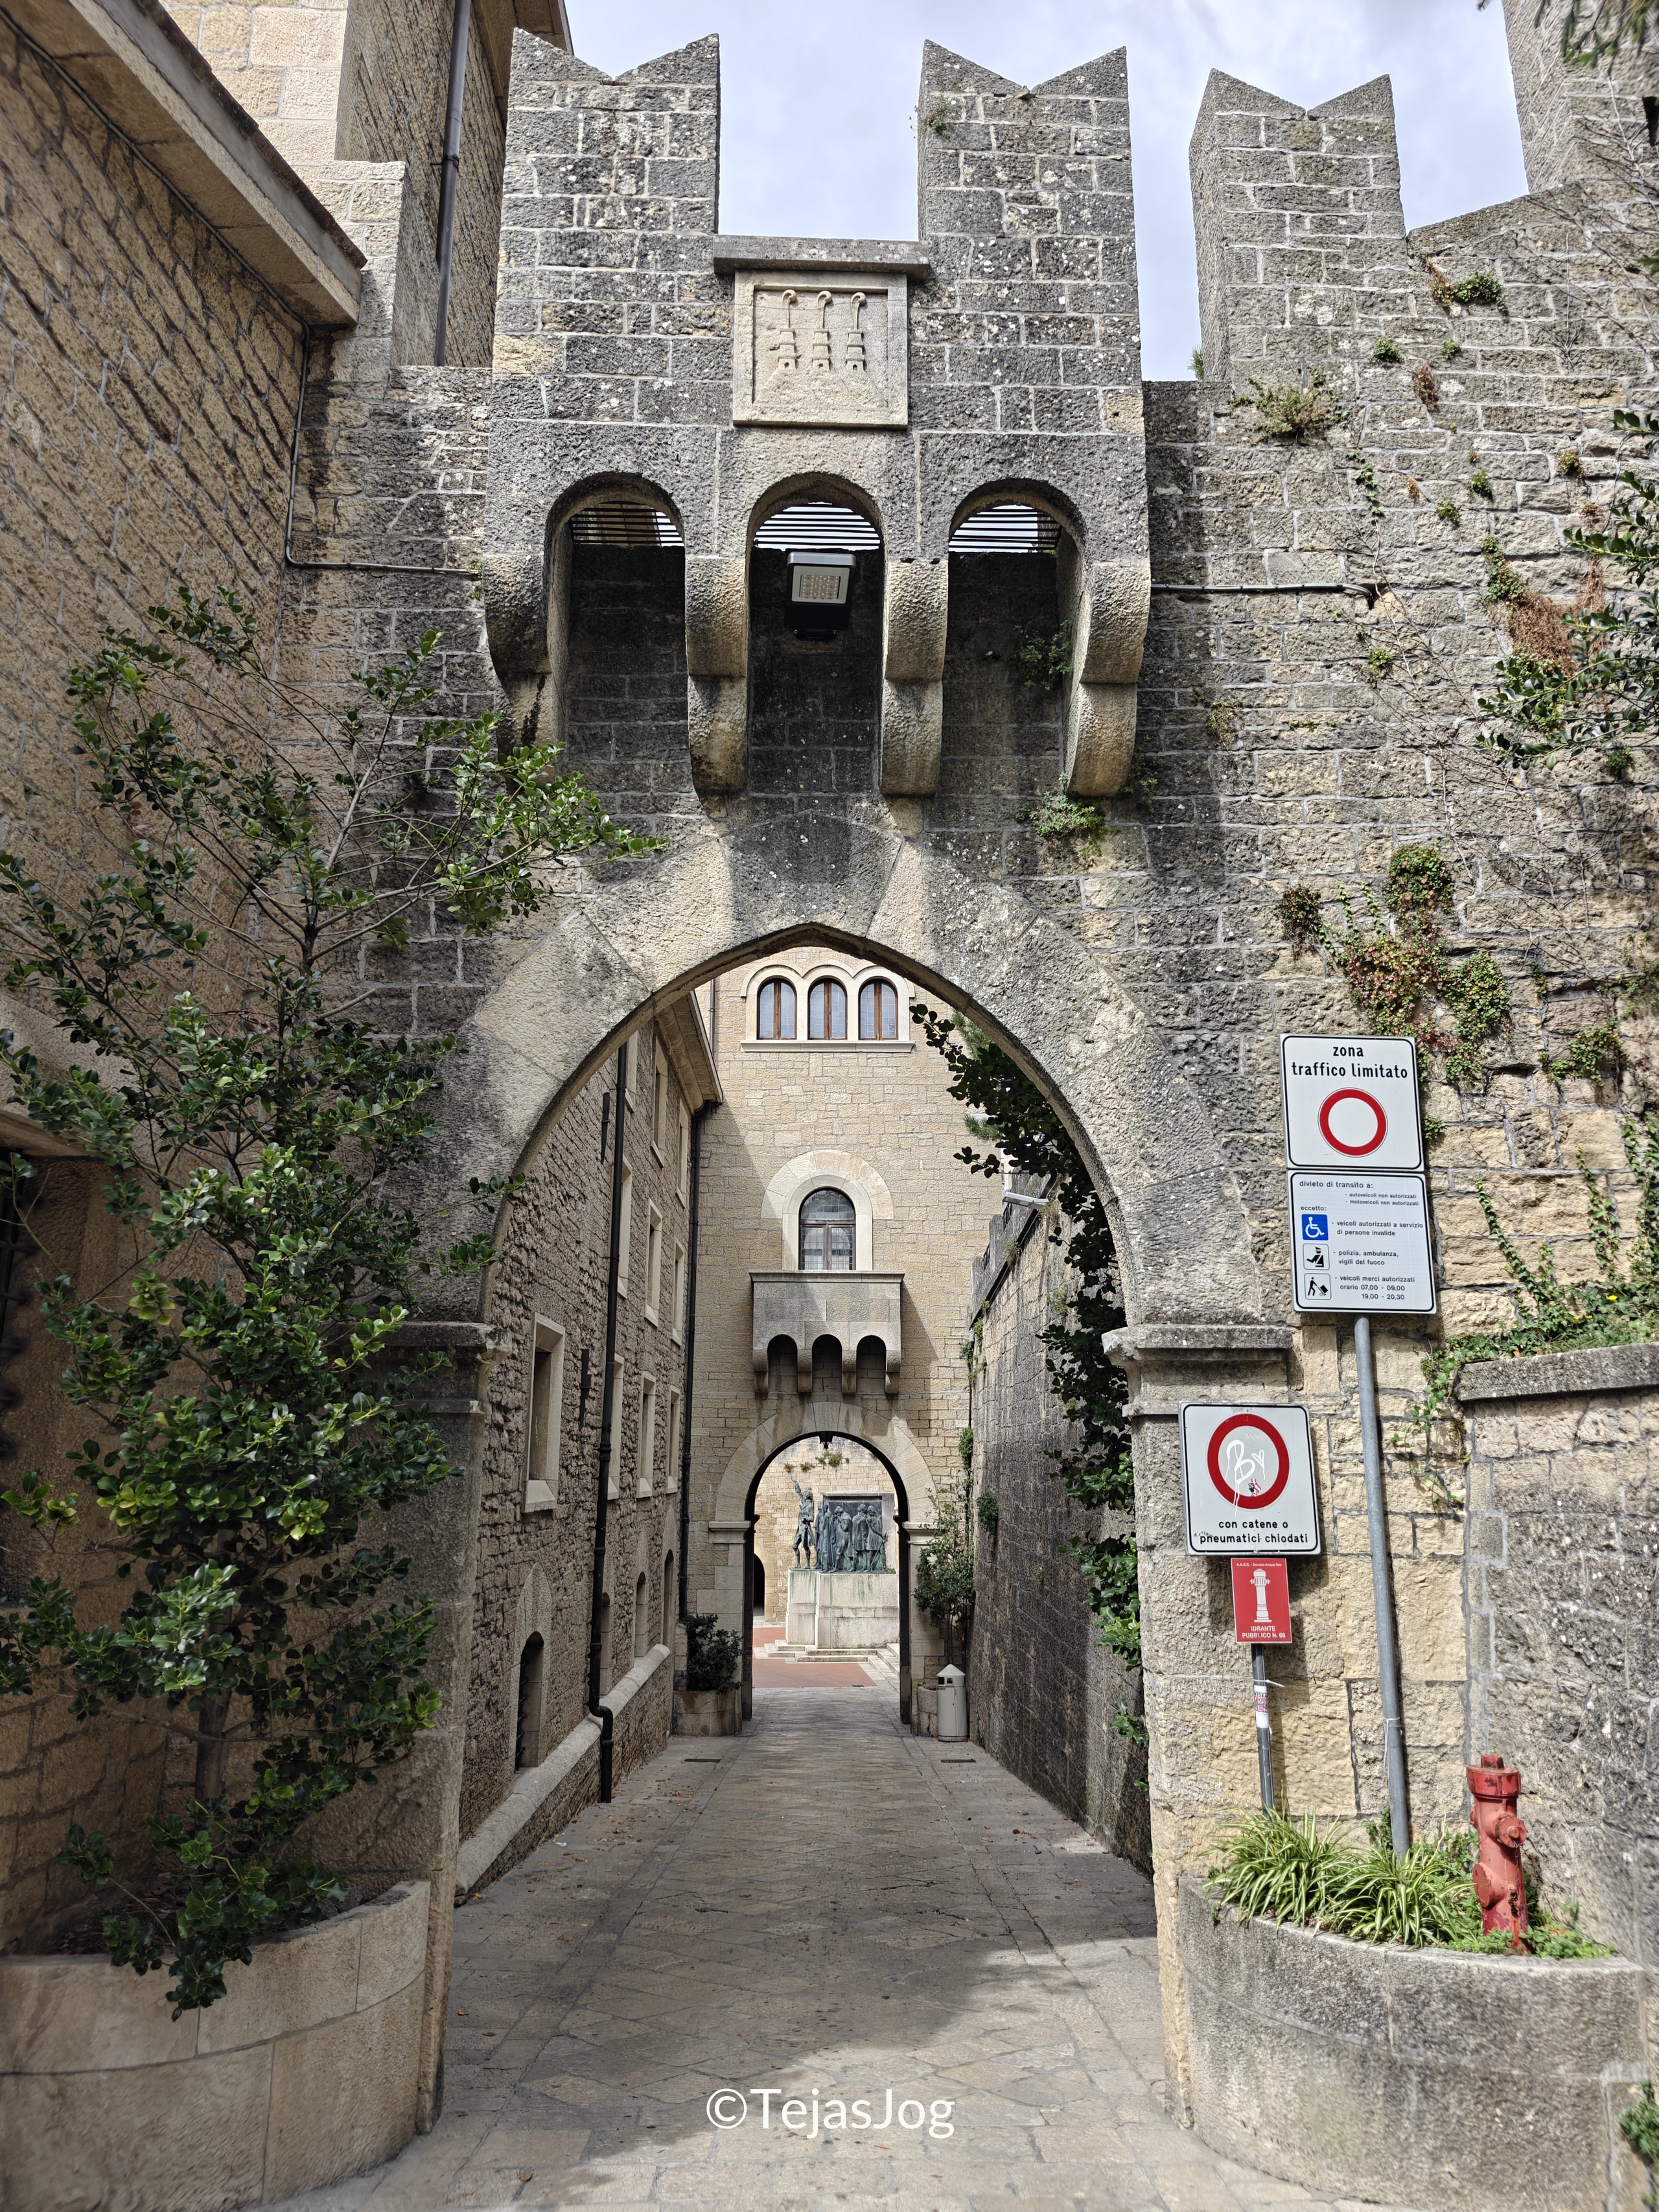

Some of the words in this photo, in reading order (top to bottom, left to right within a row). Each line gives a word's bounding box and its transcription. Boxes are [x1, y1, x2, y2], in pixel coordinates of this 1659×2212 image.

[1332, 1046, 1363, 1057] zona
[1292, 1062, 1346, 1077] traffico
[1352, 1064, 1408, 1078] limitato
[1242, 1520, 1278, 1528] catene
[1200, 1533, 1260, 1544] pneumatici
[1265, 1533, 1308, 1543] chiodati
